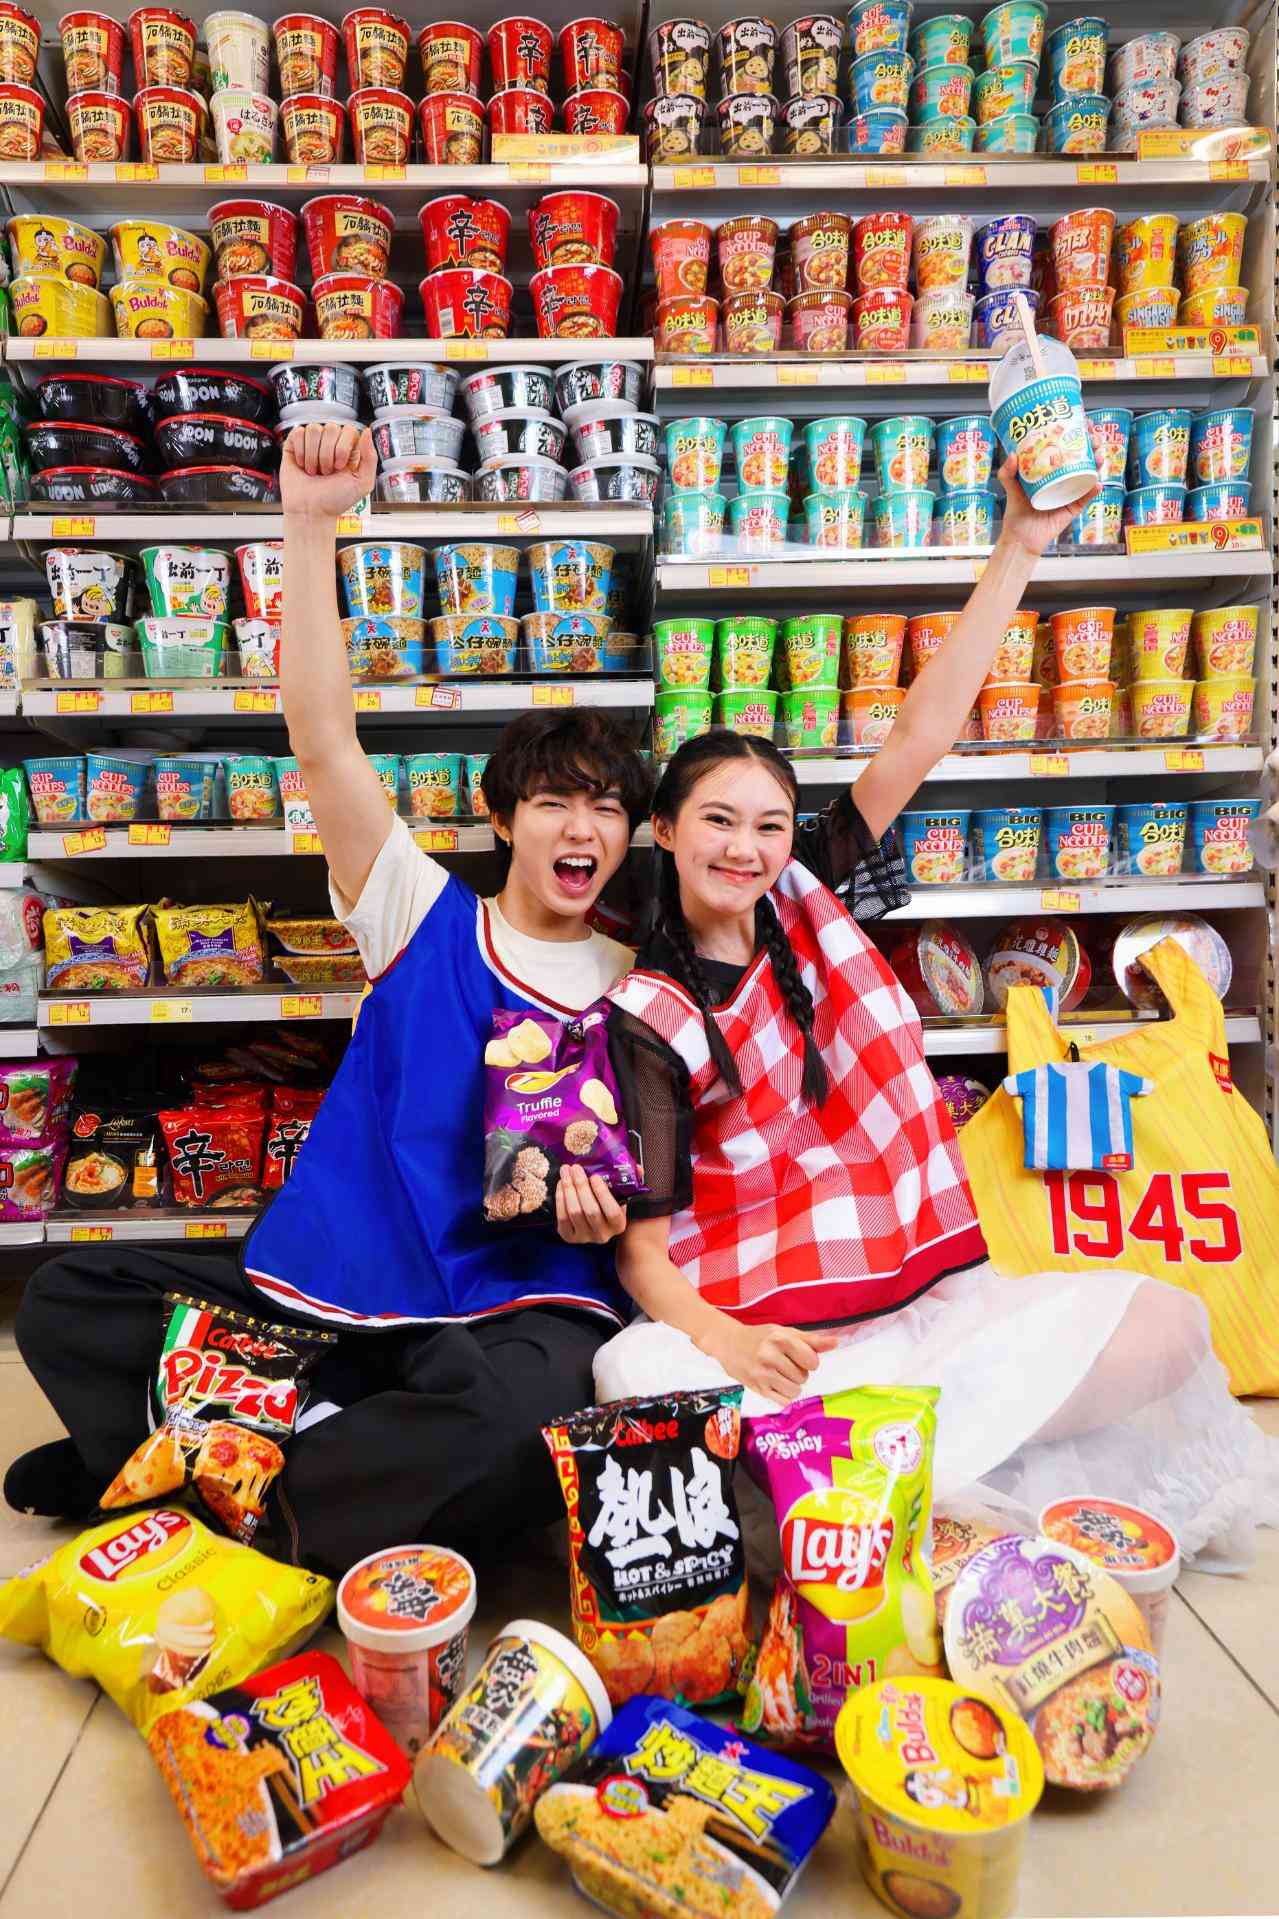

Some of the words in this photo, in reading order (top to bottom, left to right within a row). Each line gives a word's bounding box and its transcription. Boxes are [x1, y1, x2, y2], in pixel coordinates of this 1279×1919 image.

[517, 31, 546, 76] 辛
[576, 31, 601, 76] 辛
[213, 218, 262, 239] 石鍋拉麵
[448, 208, 480, 257] 辛
[534, 212, 557, 261] 辛
[734, 231, 761, 244] CUP
[863, 230, 906, 251] 合味道
[918, 231, 963, 255] 合味道
[128, 295, 169, 312] Buldak
[463, 284, 495, 333] 辛
[665, 310, 707, 330] 合味道
[1209, 328, 1229, 356] 9
[1009, 397, 1073, 443] 合味道
[223, 432, 259, 450] UDON
[956, 431, 982, 443] CUP
[48, 485, 85, 501] UDON
[1211, 524, 1229, 550] 9
[167, 561, 226, 583] 出前一丁
[1077, 620, 1104, 633] CUP
[1224, 620, 1249, 632] CUP
[452, 635, 513, 650] 公仔碗麵
[541, 633, 603, 650] 公仔碗麵
[743, 703, 769, 715] CUP
[996, 697, 1024, 710] CUP
[1153, 696, 1179, 707] CUP
[31, 772, 54, 785] CUP
[98, 771, 128, 784] CUP
[157, 772, 180, 785] CUP
[230, 772, 272, 789] 合味道
[409, 770, 452, 787] 合味道
[1070, 812, 1106, 823] BIG
[1154, 808, 1185, 820] BIG
[1215, 806, 1252, 816] BIG
[925, 816, 960, 828] BIG
[1008, 815, 1041, 827] BIG
[1071, 823, 1103, 836] CUP
[1217, 816, 1249, 830] CUP
[927, 828, 959, 841] CUP
[1058, 833, 1110, 849] NOODLES
[913, 839, 966, 854] NOODLES
[516, 1096, 562, 1116] Truffle
[171, 1128, 226, 1200] 辛
[1040, 1168, 1244, 1264] 1945
[162, 1346, 300, 1427] Pizza
[778, 1434, 824, 1461] Spicy
[86, 1509, 183, 1580] Lay's
[791, 1518, 893, 1593] Lay's
[157, 1547, 218, 1592] Classic
[613, 1566, 653, 1588] HOT
[654, 1561, 671, 1579] &
[672, 1543, 735, 1578] SPICY
[897, 1691, 938, 1766] Buldak
